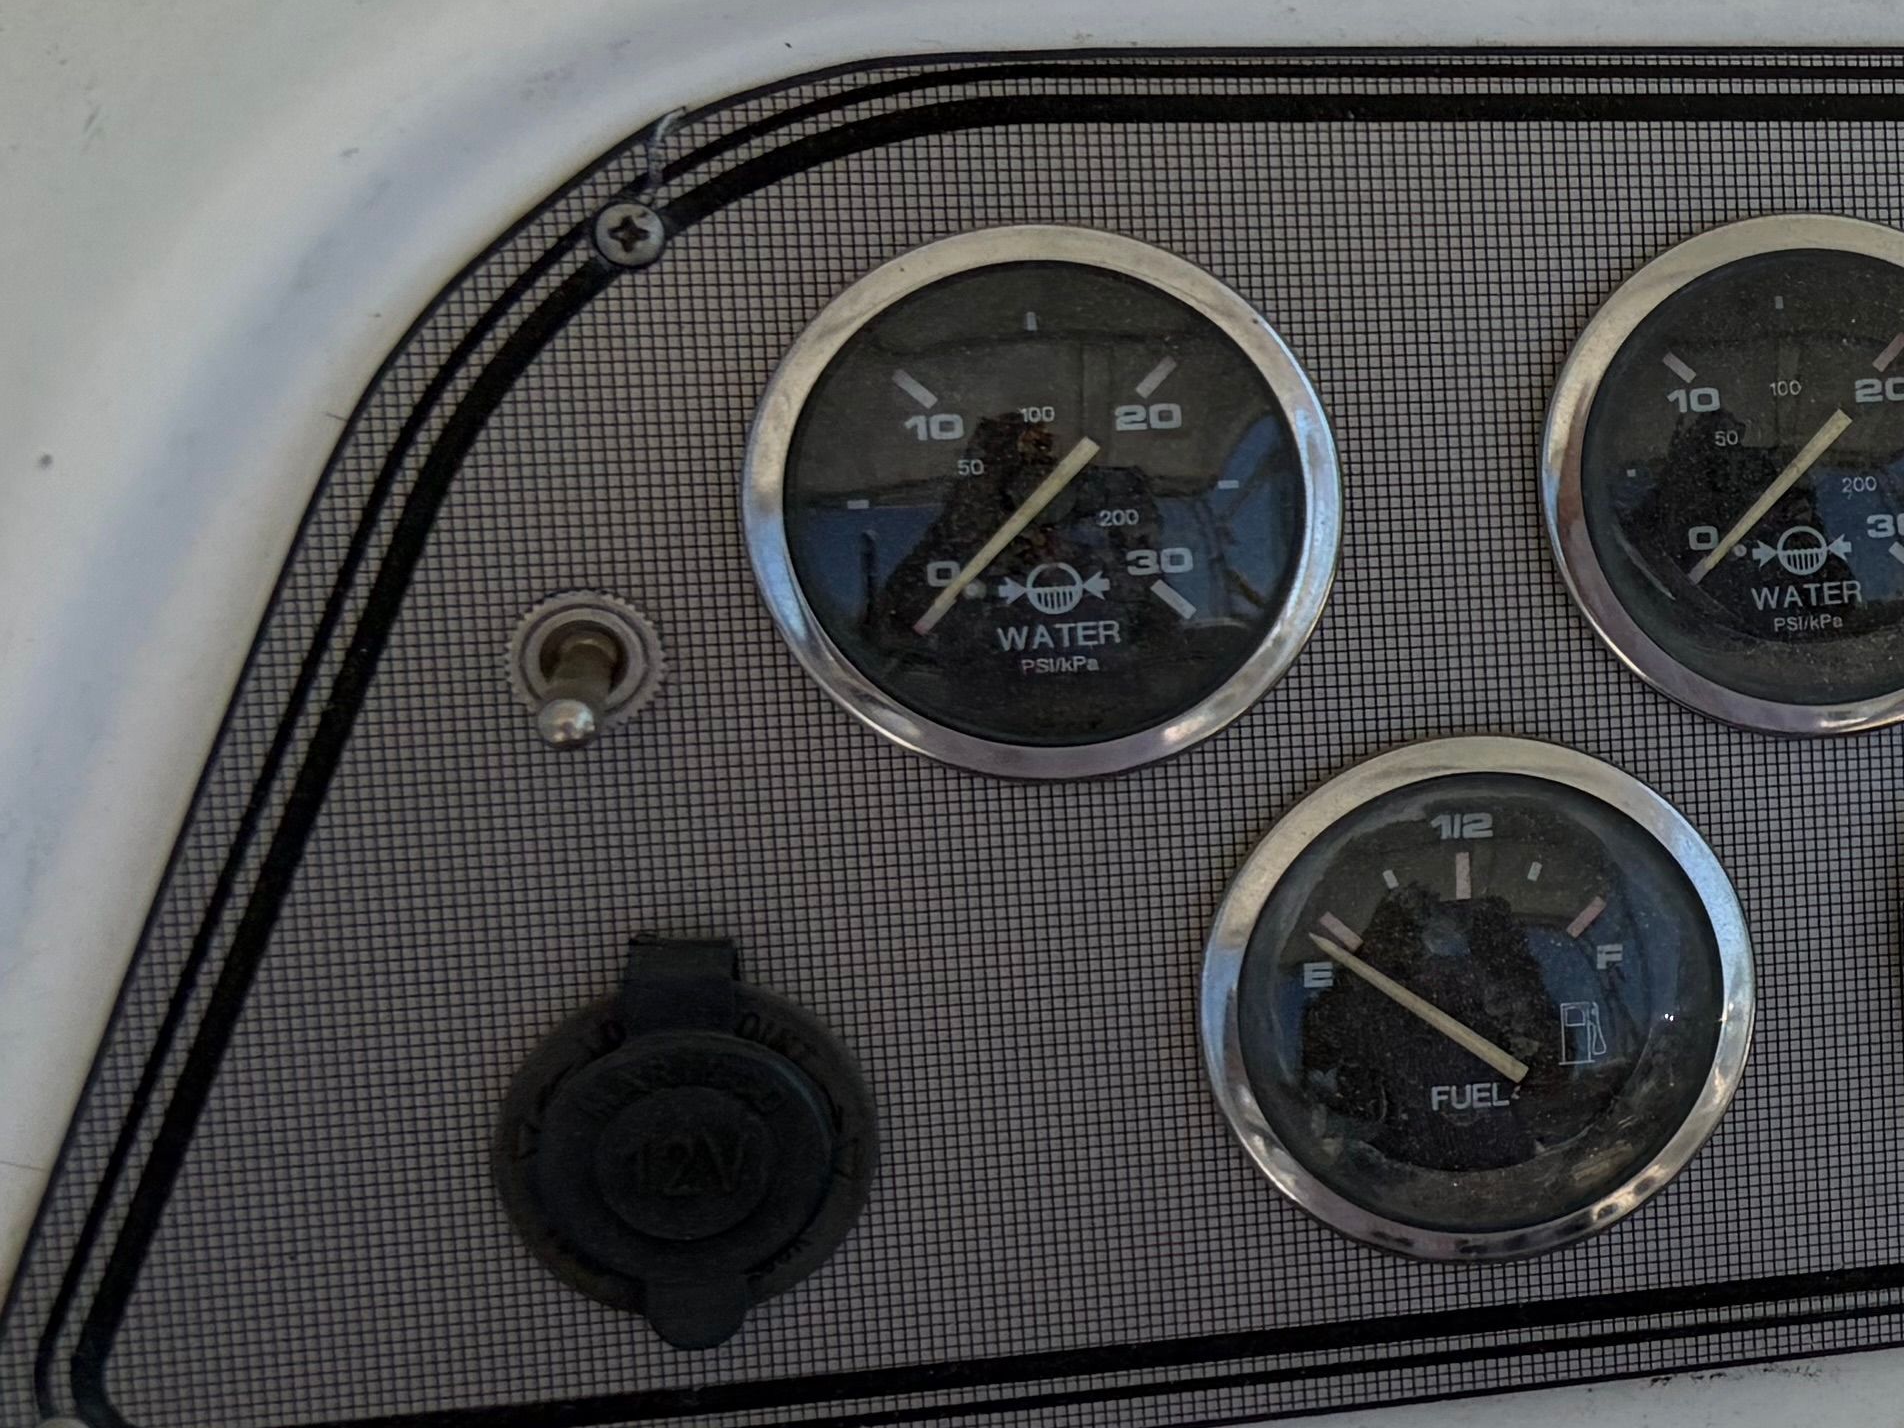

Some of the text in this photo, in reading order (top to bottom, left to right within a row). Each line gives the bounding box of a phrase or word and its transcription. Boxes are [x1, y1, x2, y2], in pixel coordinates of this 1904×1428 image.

[1667, 387, 1720, 413] 10
[1769, 380, 1801, 396] 100
[904, 414, 964, 440] 10
[1019, 406, 1055, 424] 100
[1114, 404, 1182, 430] 20
[1715, 430, 1738, 446] 50
[957, 459, 984, 475] 50
[1841, 477, 1877, 493] 200
[1100, 509, 1139, 526] 200
[1688, 526, 1718, 550] 0
[1127, 548, 1194, 577] 30
[1751, 582, 1862, 611] WATER
[997, 621, 1121, 652] WATER
[1597, 944, 1622, 968] F
[1303, 962, 1333, 989] E
[1431, 1084, 1510, 1110] FUEL
